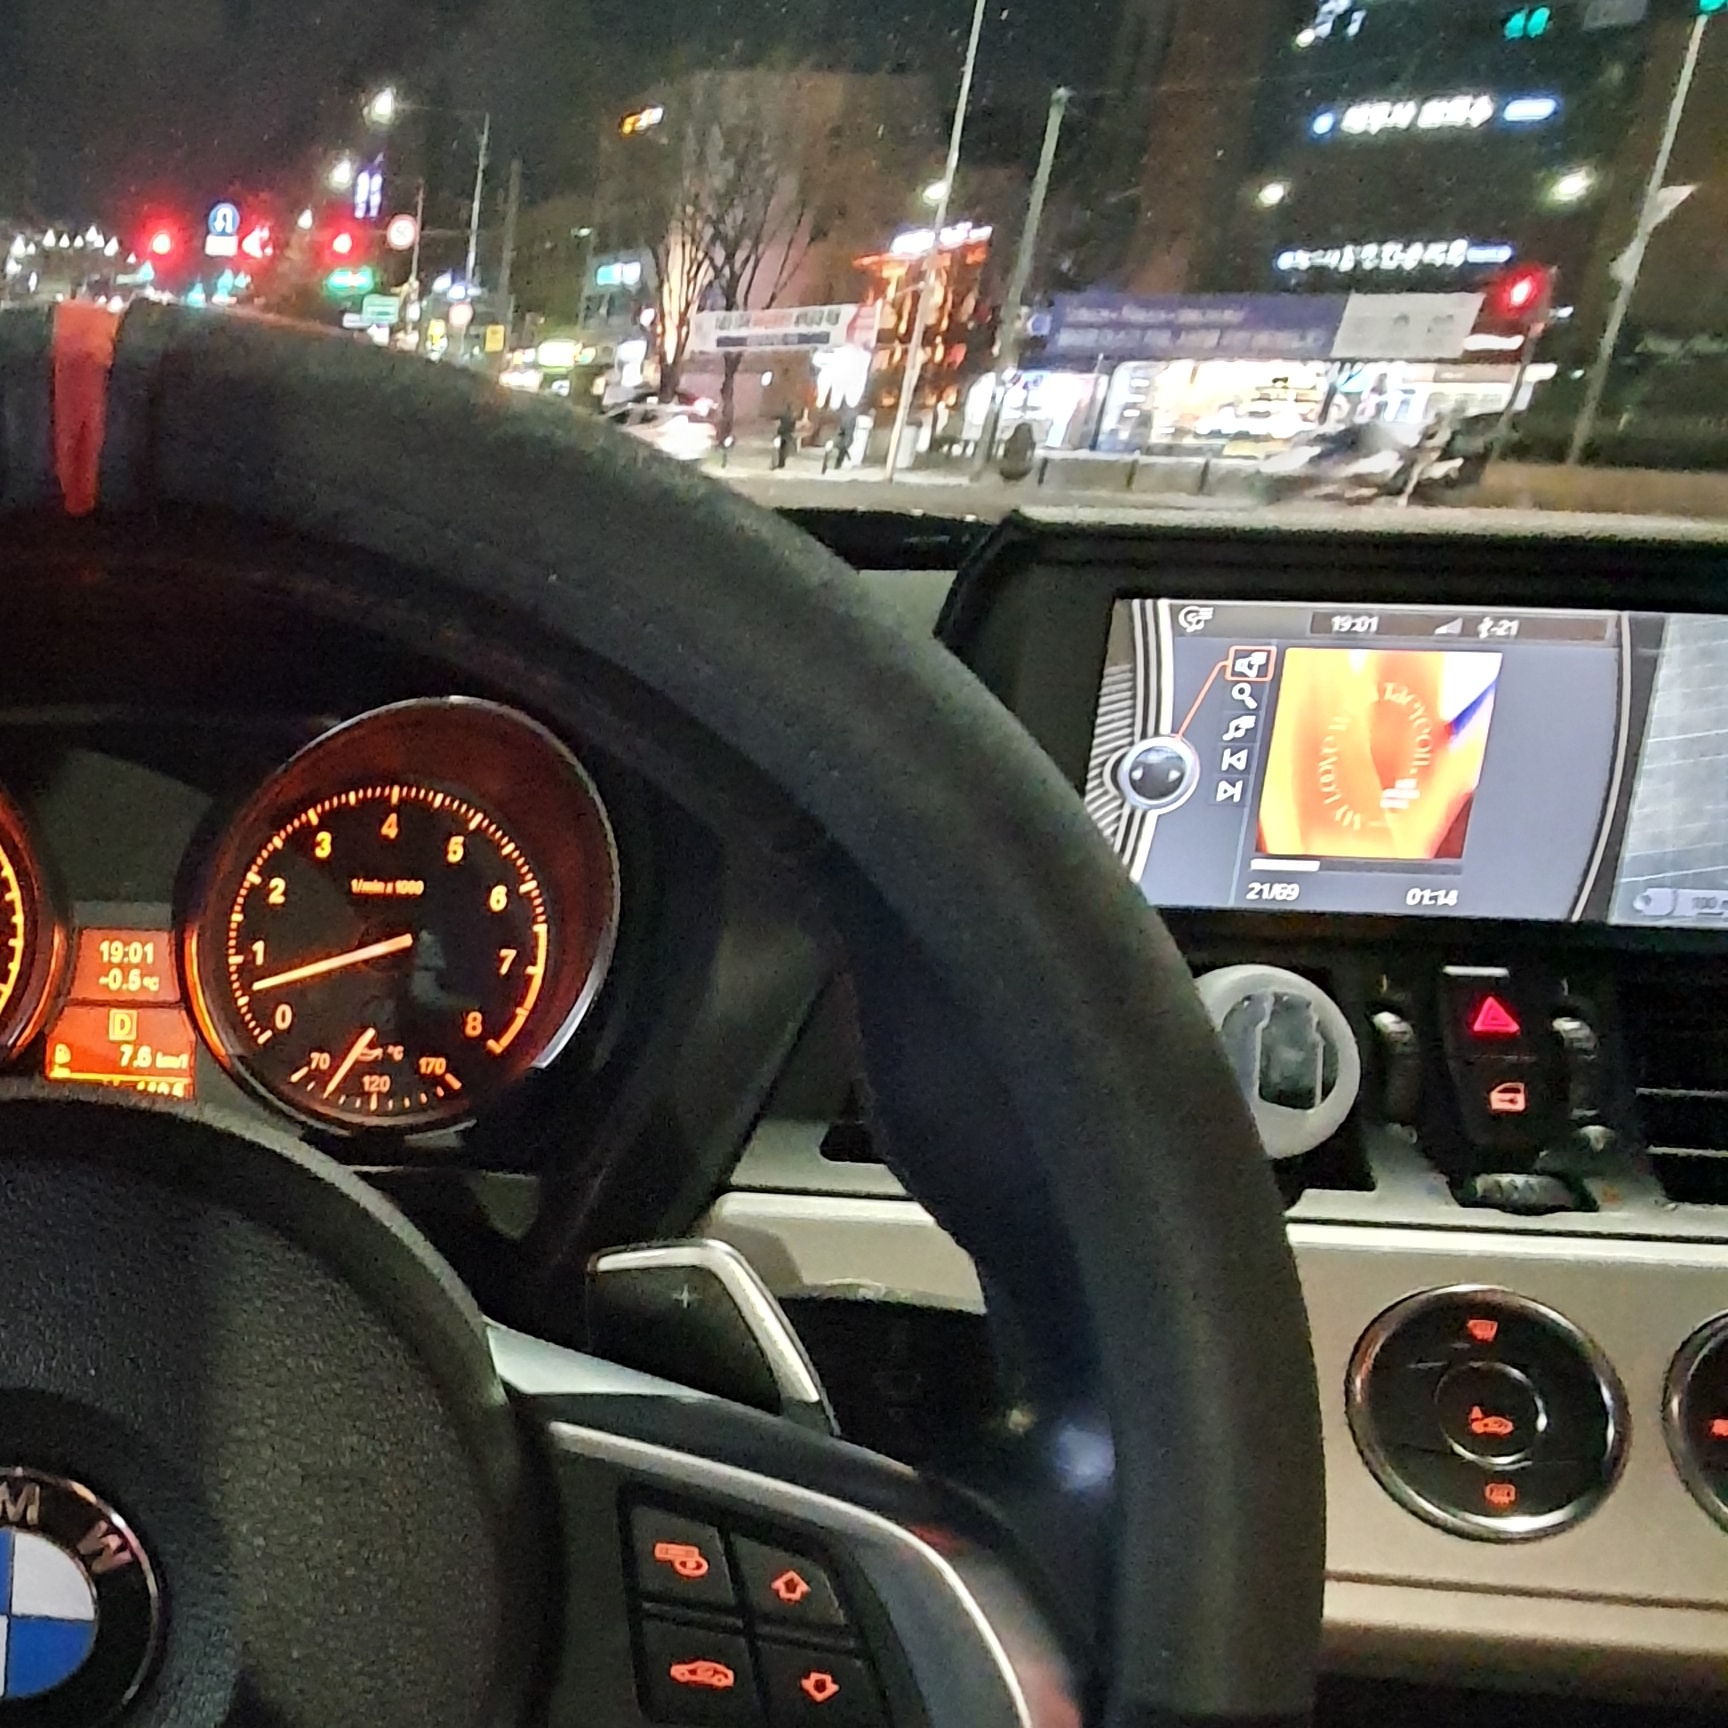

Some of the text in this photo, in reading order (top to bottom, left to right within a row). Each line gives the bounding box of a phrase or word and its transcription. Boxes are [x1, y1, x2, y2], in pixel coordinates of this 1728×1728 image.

[380, 812, 399, 839] 4
[314, 831, 332, 858] 3
[446, 835, 465, 863] 5
[268, 877, 286, 904] 2
[489, 884, 508, 912] 6
[98, 940, 154, 965] 19:01
[251, 939, 265, 965] 1
[499, 948, 517, 976] 7
[114, 1013, 132, 1036] D
[274, 1004, 293, 1030] 0
[463, 1011, 483, 1037] 8
[309, 1051, 331, 1071] 70
[418, 1056, 447, 1076] 170
[362, 1074, 391, 1093] 120
